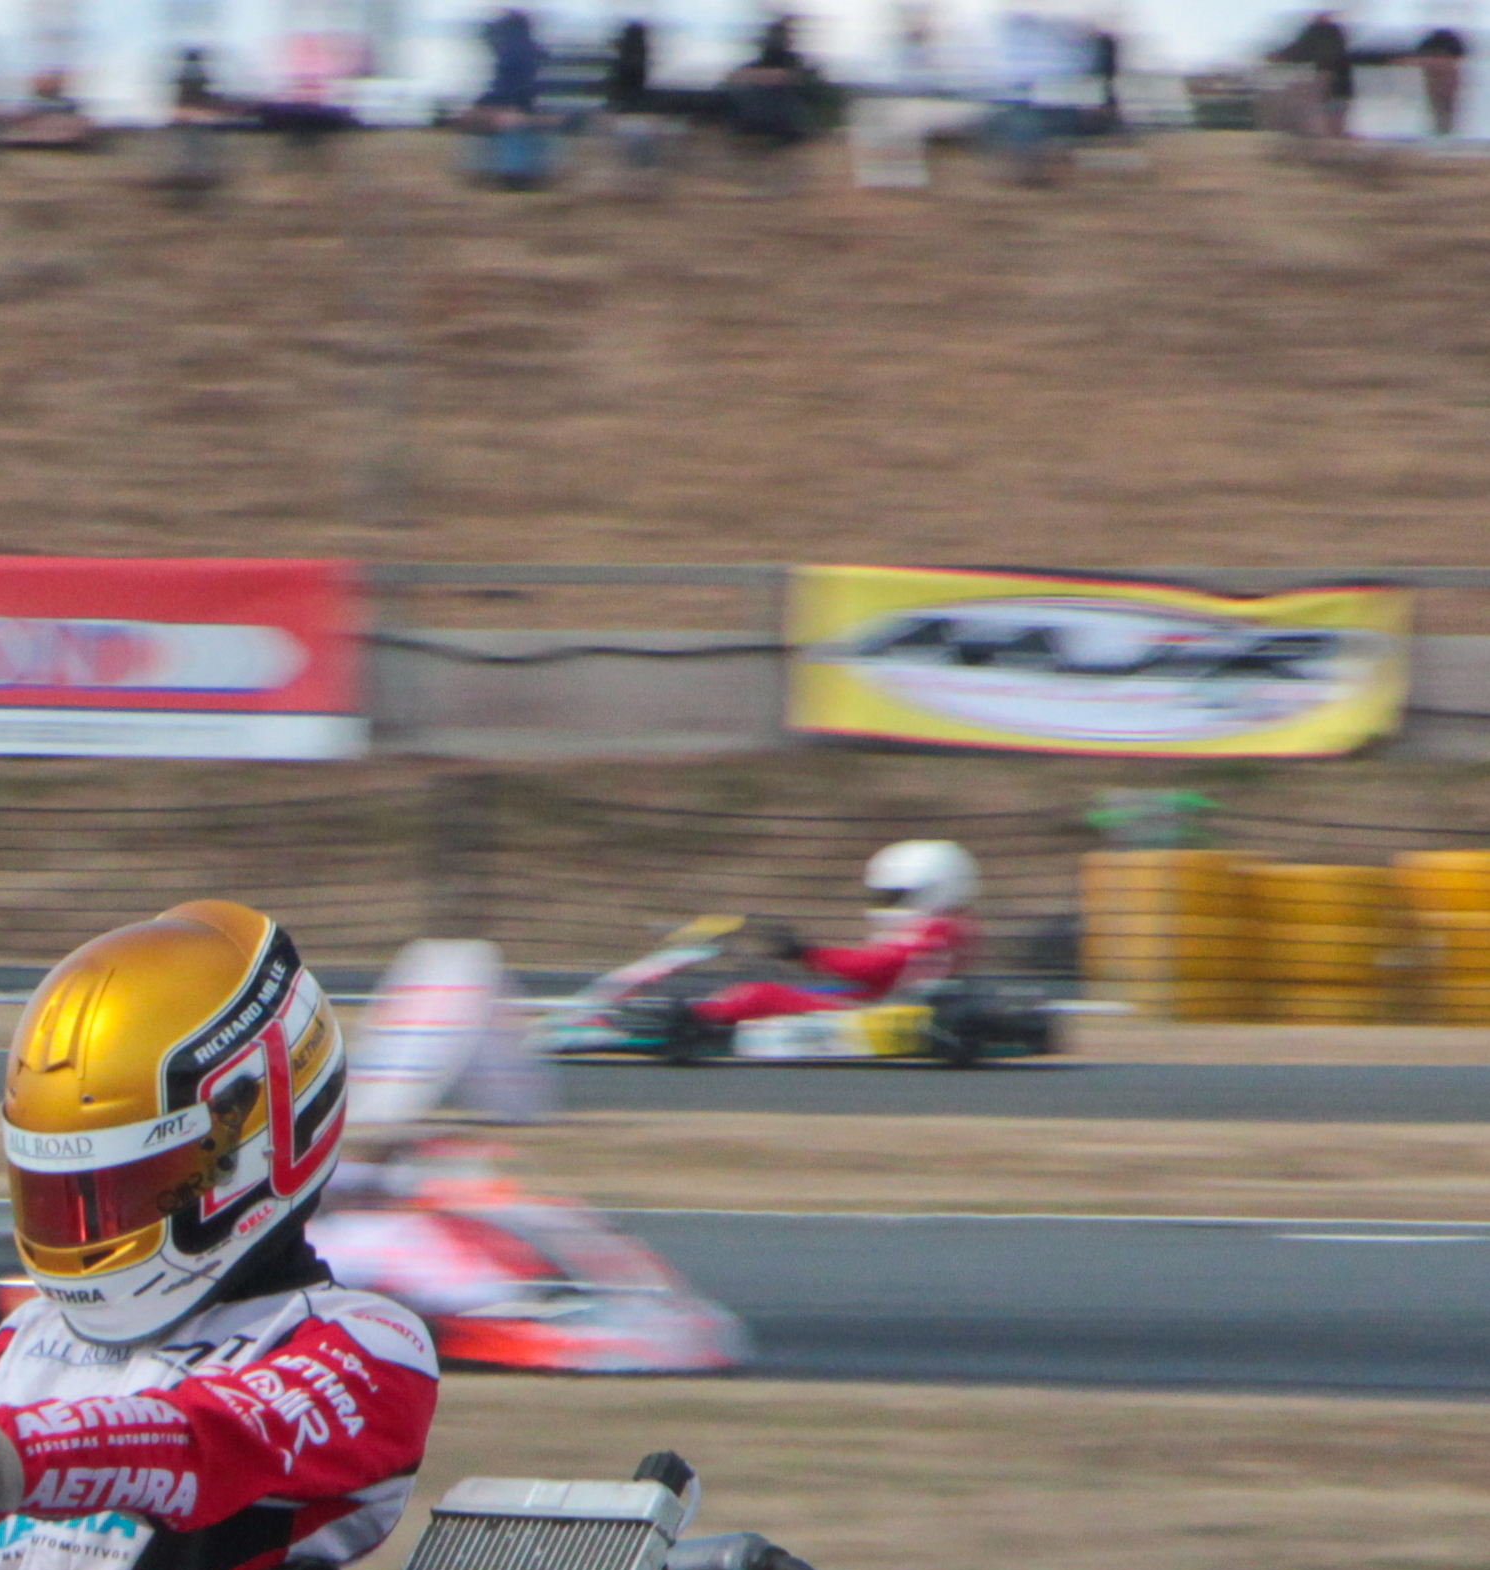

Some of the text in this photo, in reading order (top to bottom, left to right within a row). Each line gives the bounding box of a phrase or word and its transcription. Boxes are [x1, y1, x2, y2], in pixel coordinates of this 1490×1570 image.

[194, 959, 287, 1064] RICHARD MILLE
[34, 1136, 94, 1157] ROAD
[143, 1112, 189, 1148] ART
[238, 1204, 275, 1235] BELL
[26, 1338, 73, 1359] ALL
[15, 1396, 189, 1440] AETHRA
[22, 1466, 198, 1517] AETHRA
